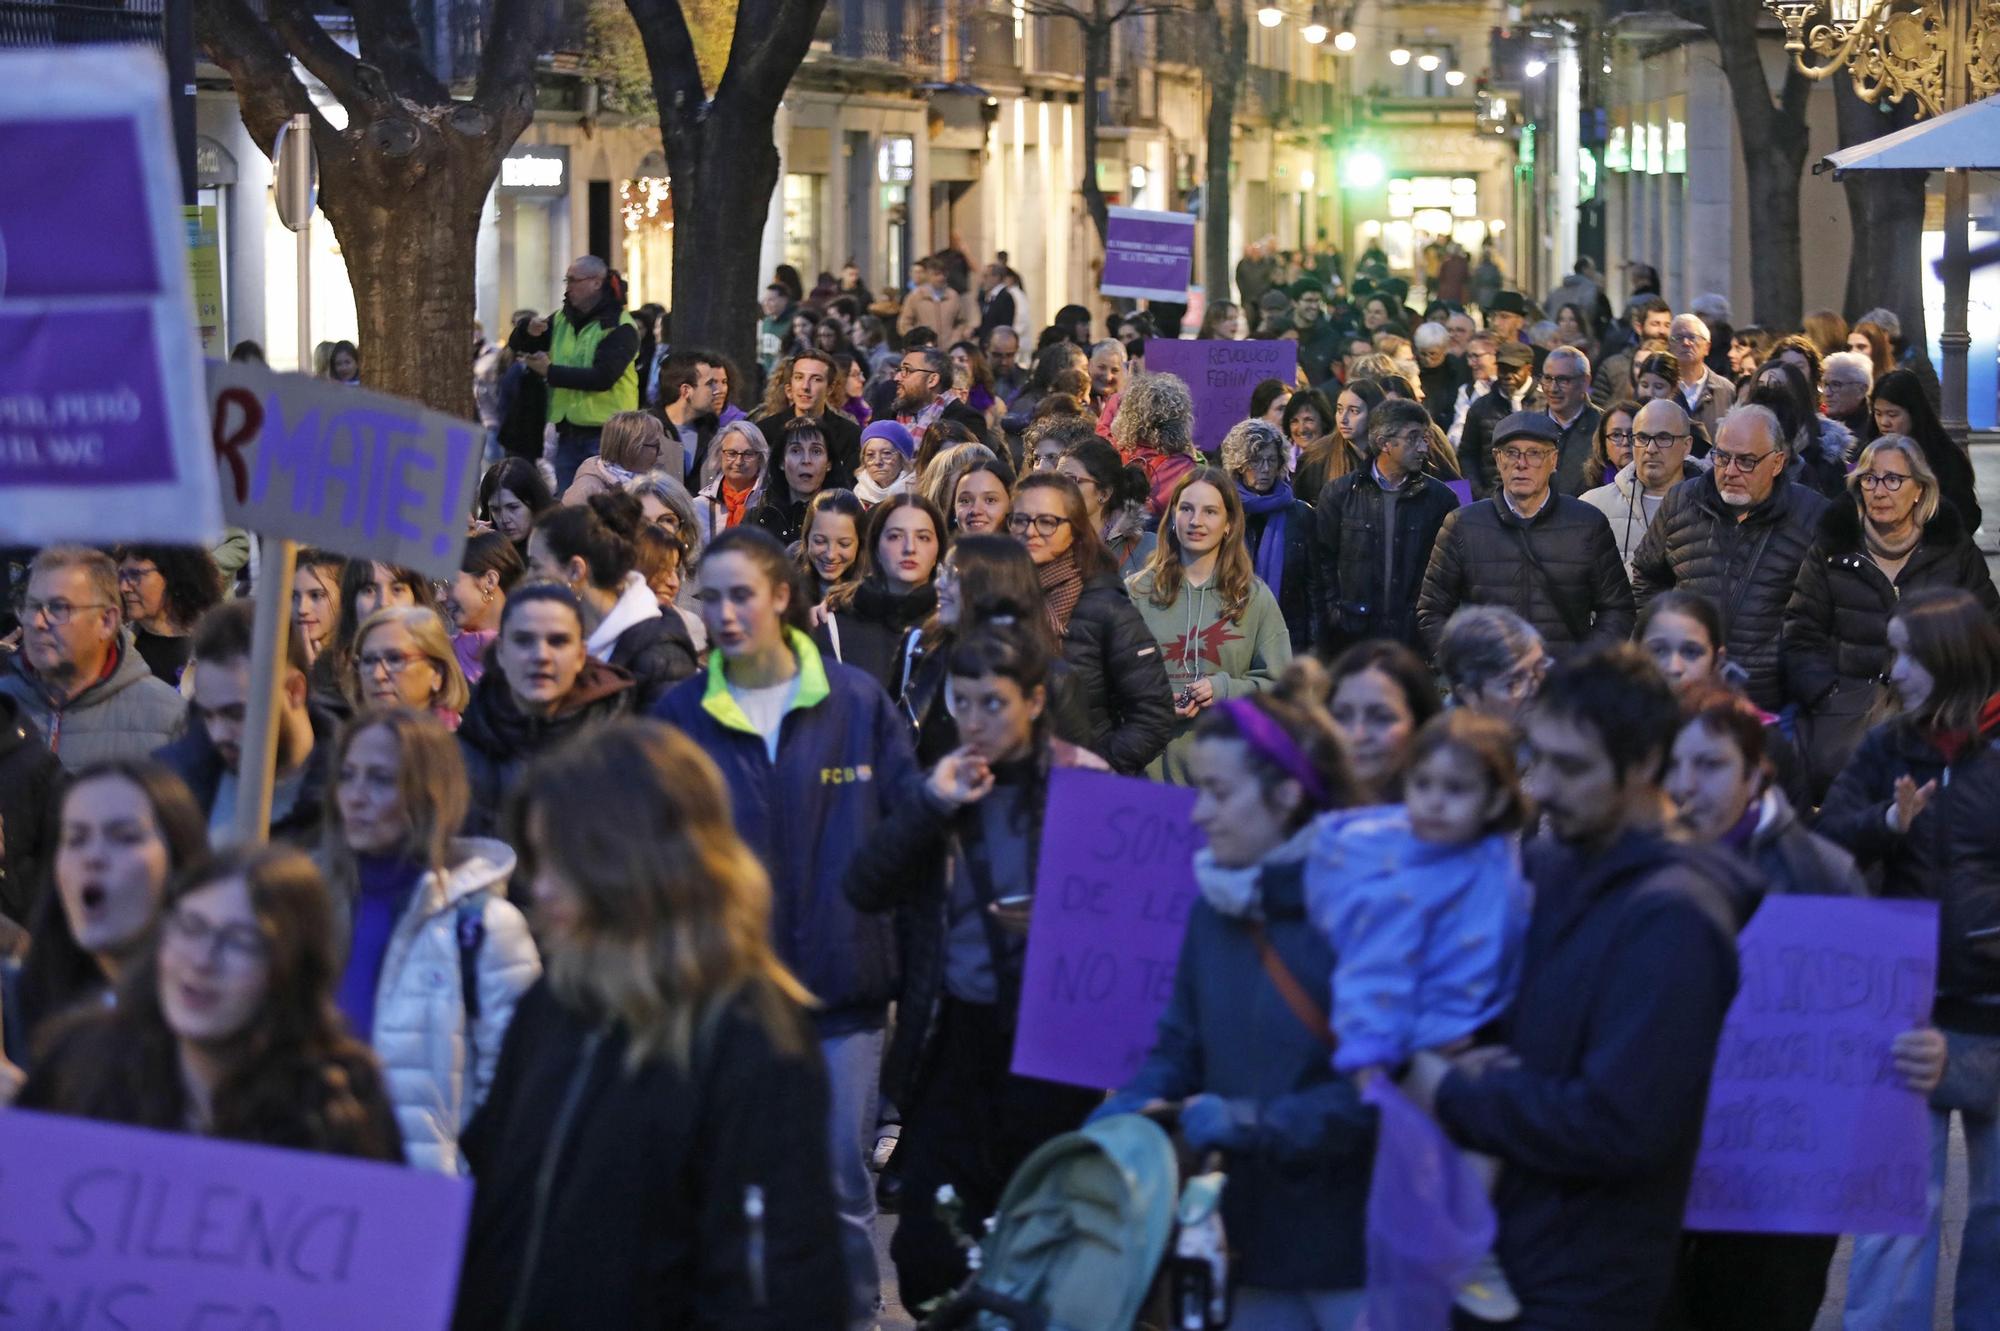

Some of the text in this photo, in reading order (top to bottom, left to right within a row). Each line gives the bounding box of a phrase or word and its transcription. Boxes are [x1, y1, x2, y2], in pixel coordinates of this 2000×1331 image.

[1060, 874, 1112, 914] DE
[1052, 946, 1117, 1005] NO
[52, 1166, 362, 1284] SILENCI
